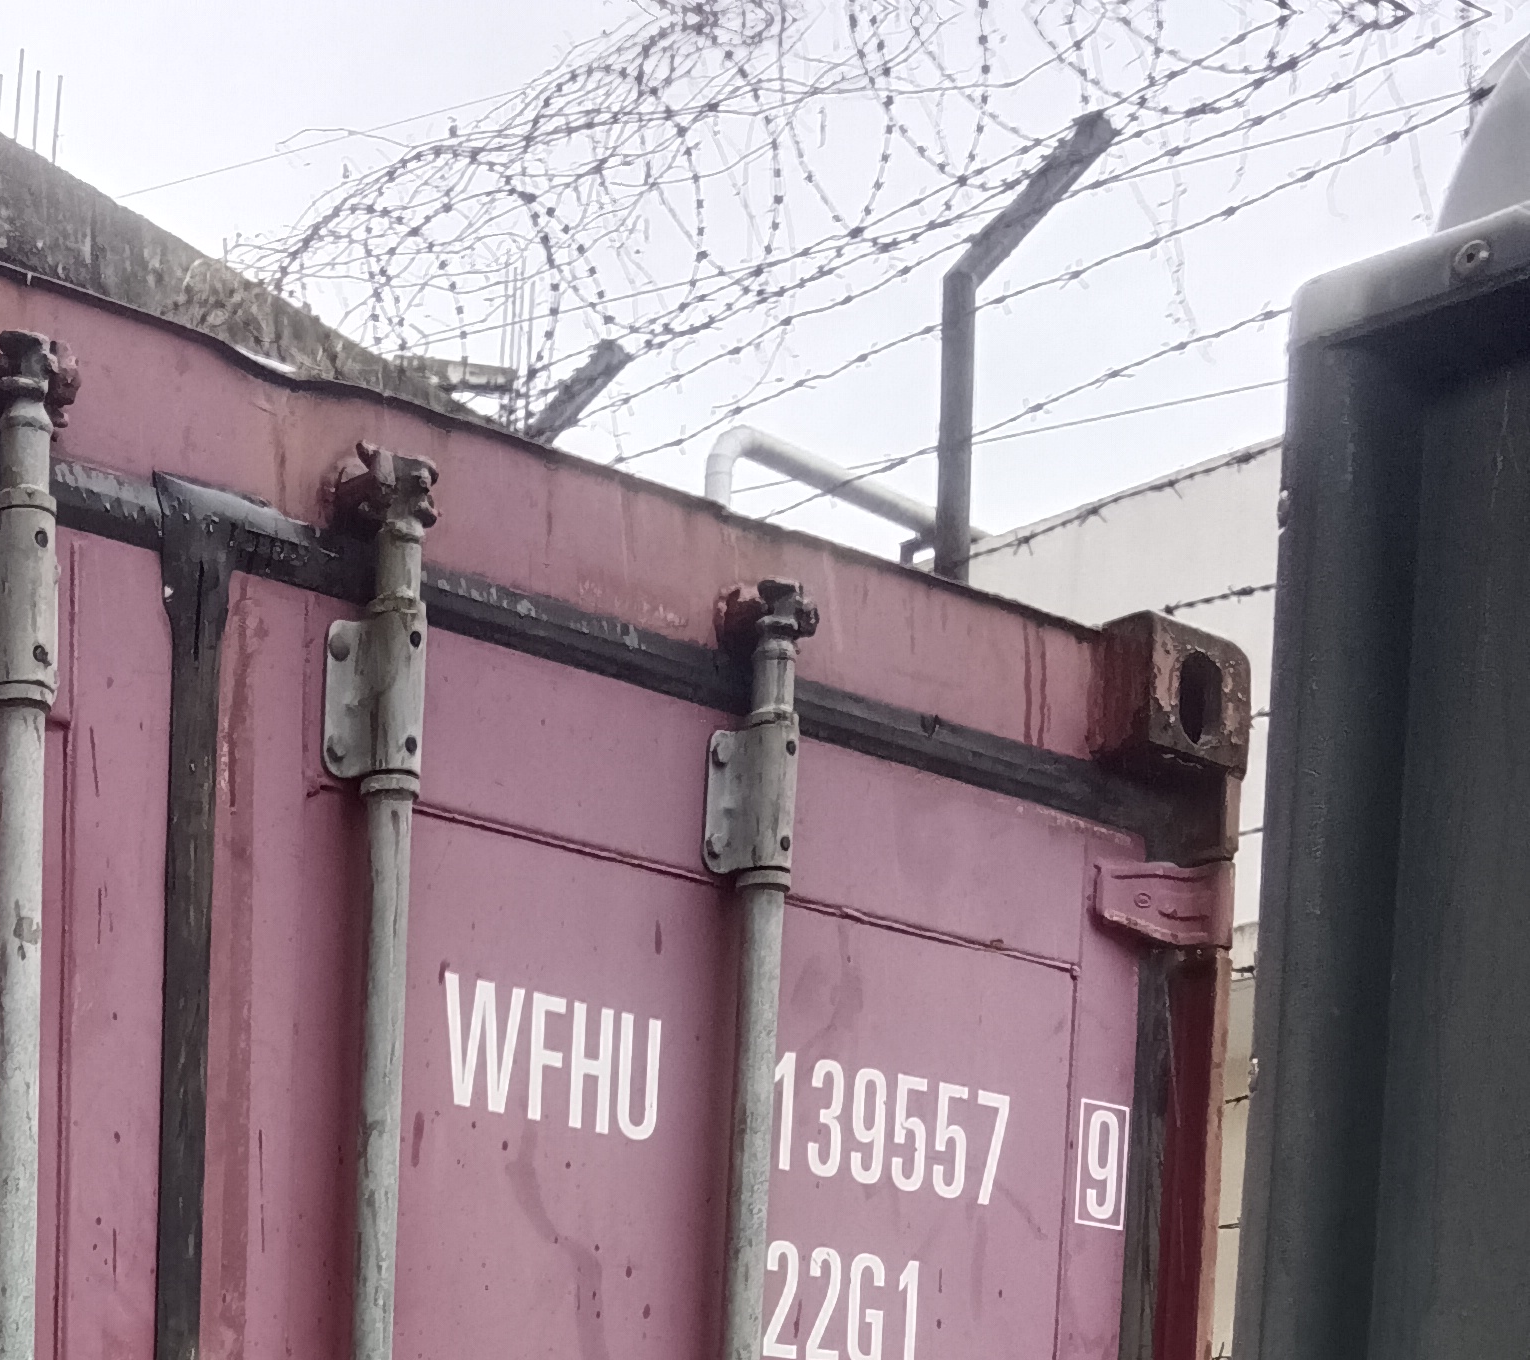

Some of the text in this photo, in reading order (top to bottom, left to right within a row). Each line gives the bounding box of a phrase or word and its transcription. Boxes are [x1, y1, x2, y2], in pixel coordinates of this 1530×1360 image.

[444, 971, 1121, 1221] WFHU 139557 9
